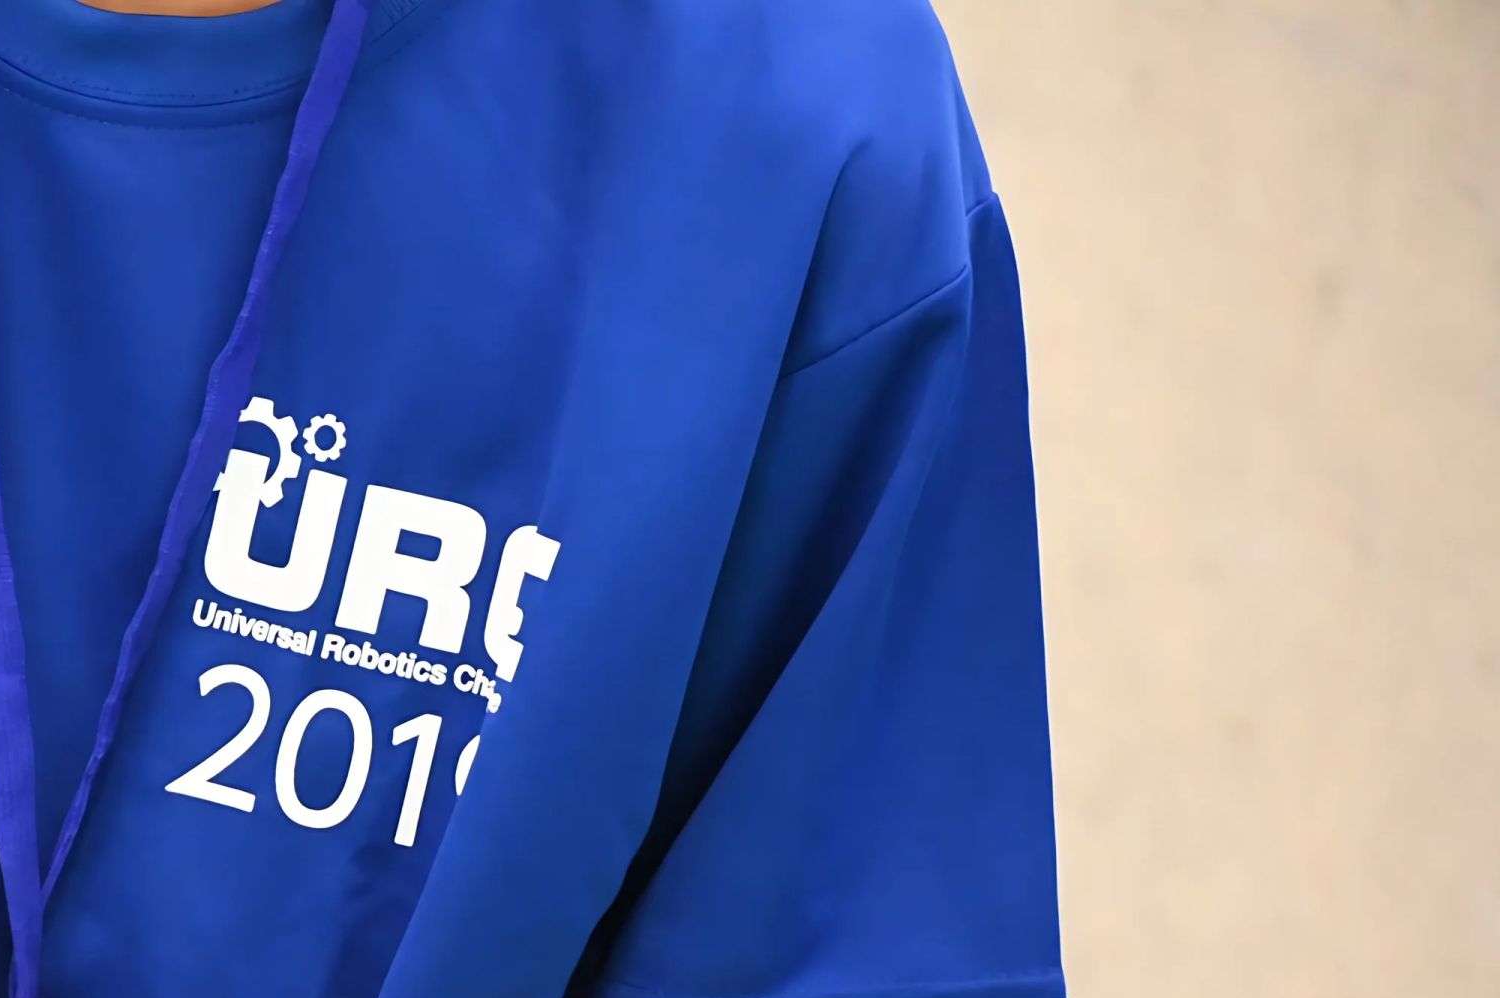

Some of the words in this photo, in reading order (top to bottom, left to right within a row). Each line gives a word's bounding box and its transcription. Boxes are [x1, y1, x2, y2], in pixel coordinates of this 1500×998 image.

[192, 598, 317, 656] Universal
[320, 633, 447, 686] Robotics
[165, 664, 480, 847] 201
